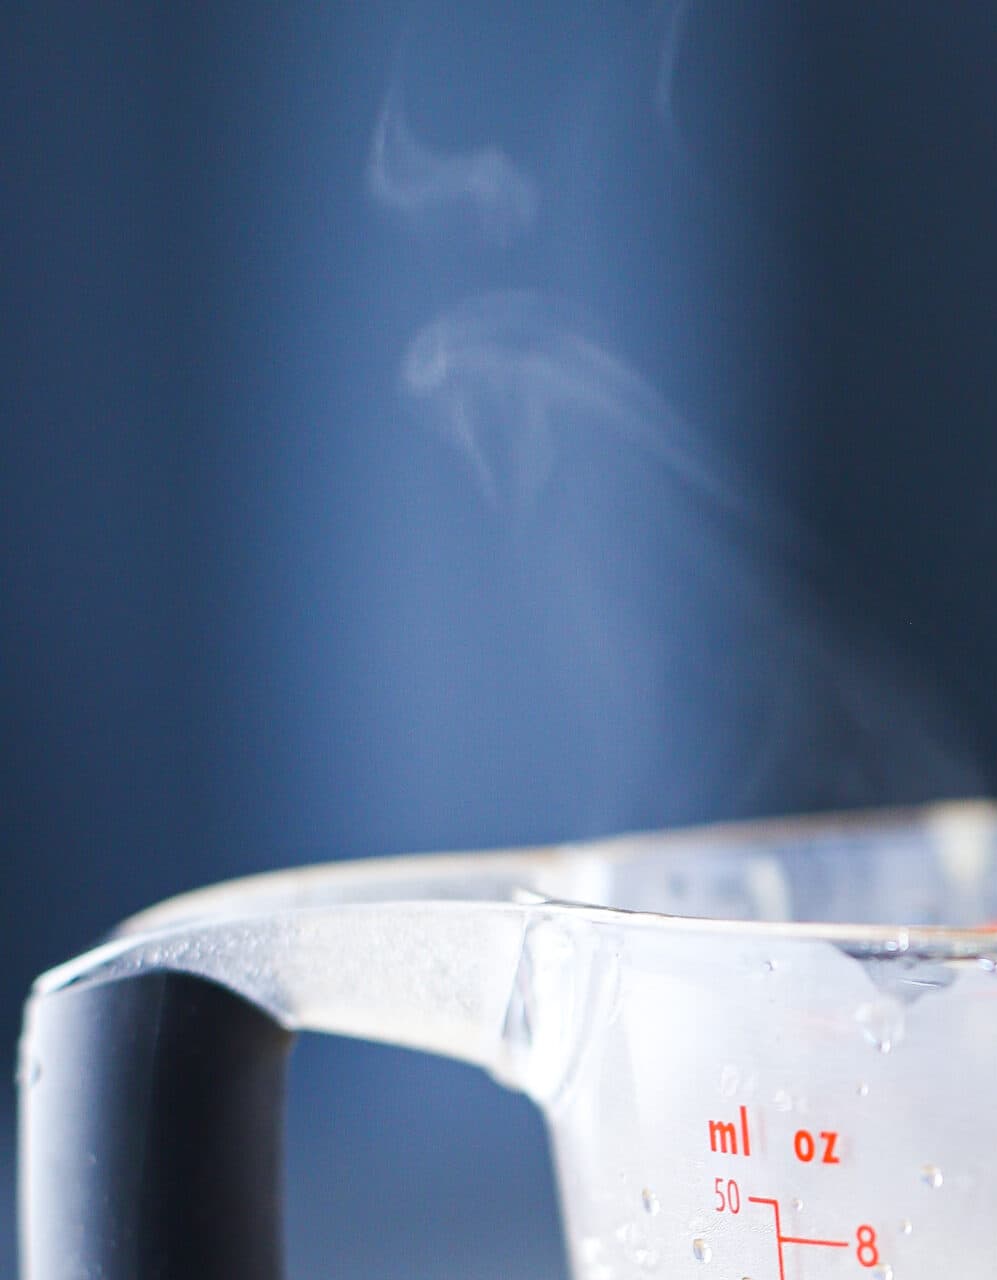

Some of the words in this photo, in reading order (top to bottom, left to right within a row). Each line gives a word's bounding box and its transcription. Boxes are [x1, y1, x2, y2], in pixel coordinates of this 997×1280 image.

[708, 1105, 750, 1156] ml
[794, 1130, 840, 1163] oz
[714, 1178, 741, 1214] 50
[856, 1225, 879, 1267] 8
